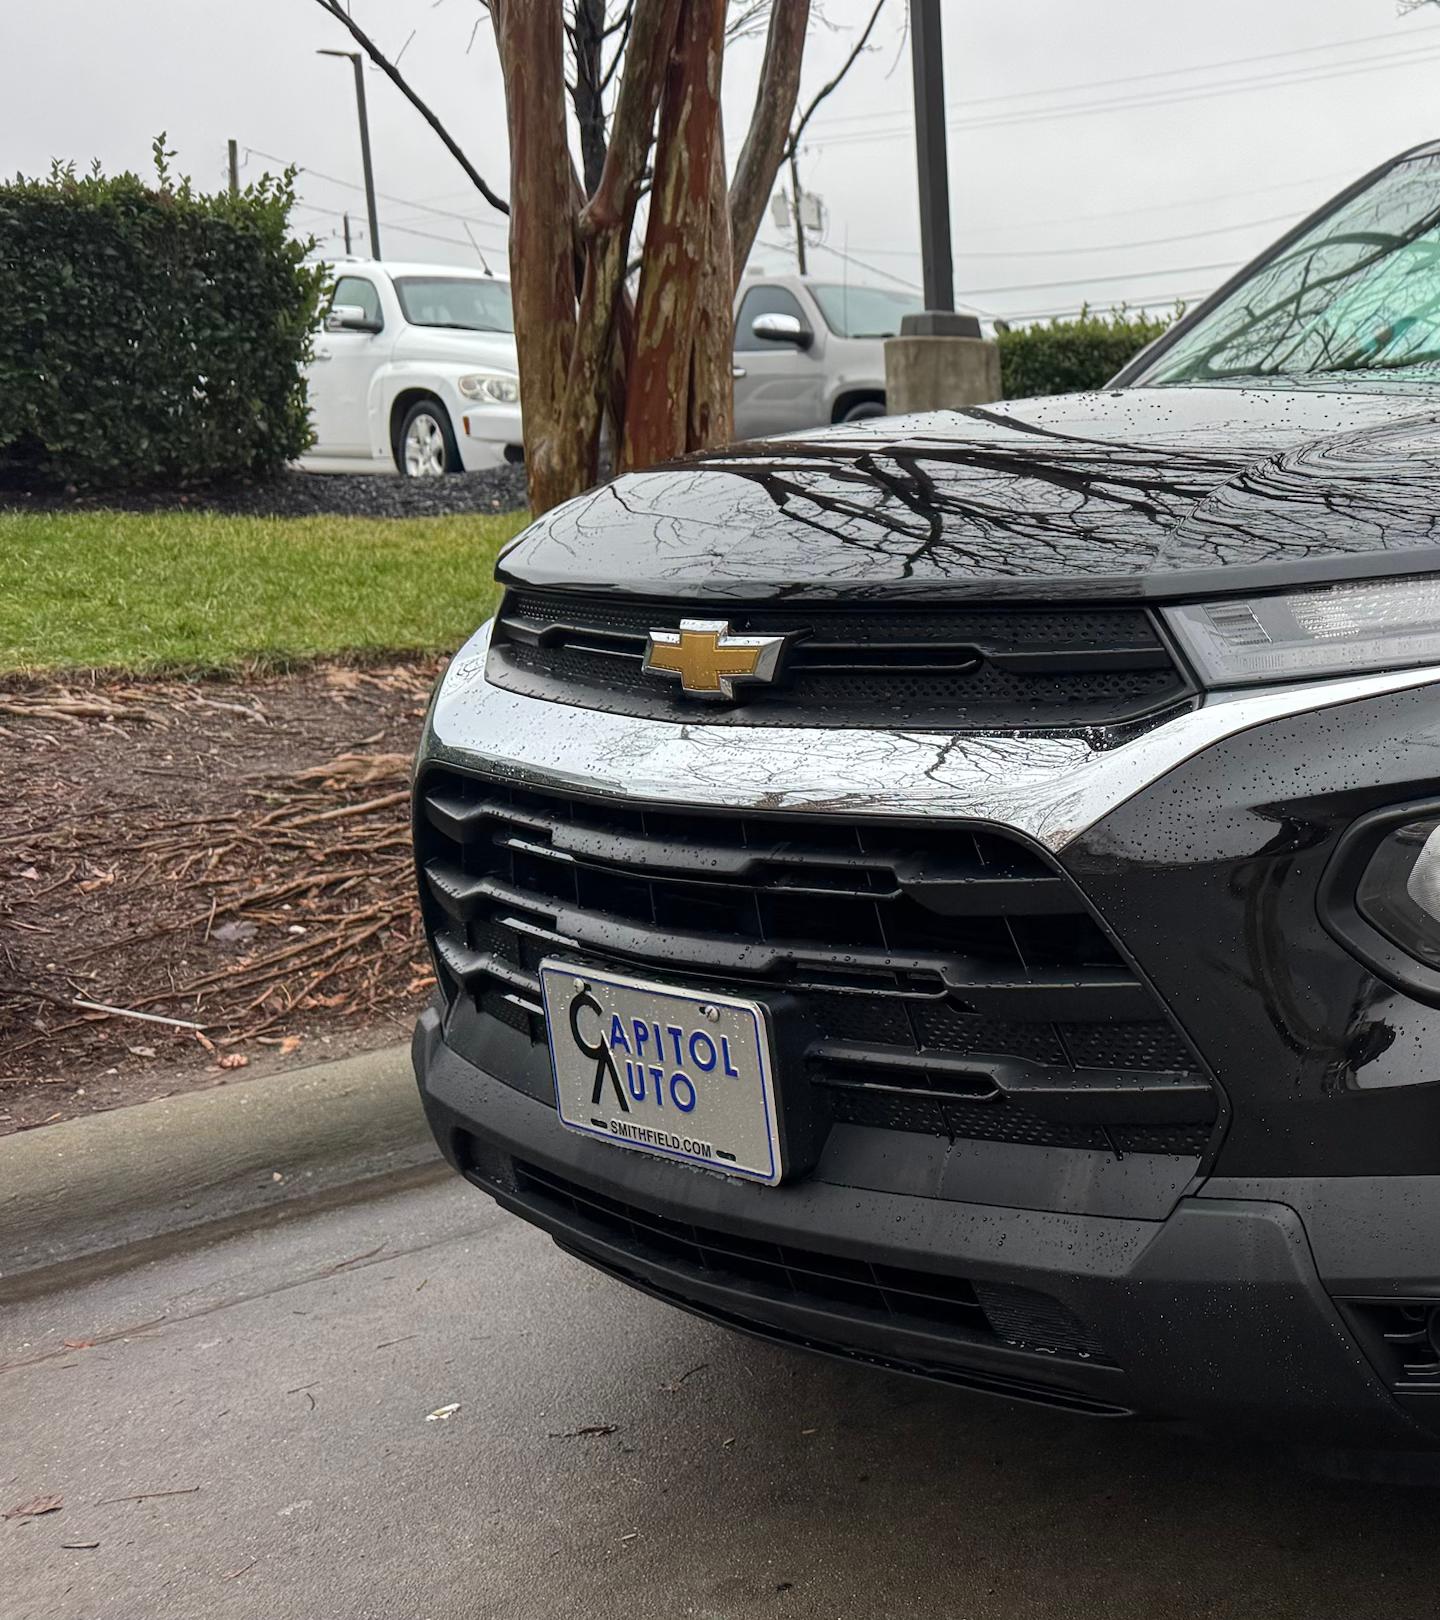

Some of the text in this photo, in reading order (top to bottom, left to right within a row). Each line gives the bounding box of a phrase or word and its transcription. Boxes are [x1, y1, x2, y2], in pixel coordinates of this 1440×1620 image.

[569, 989, 739, 1078] CAPITOL
[591, 1030, 697, 1114] AUTO
[610, 1120, 712, 1158] SMITHFIELD.COM
